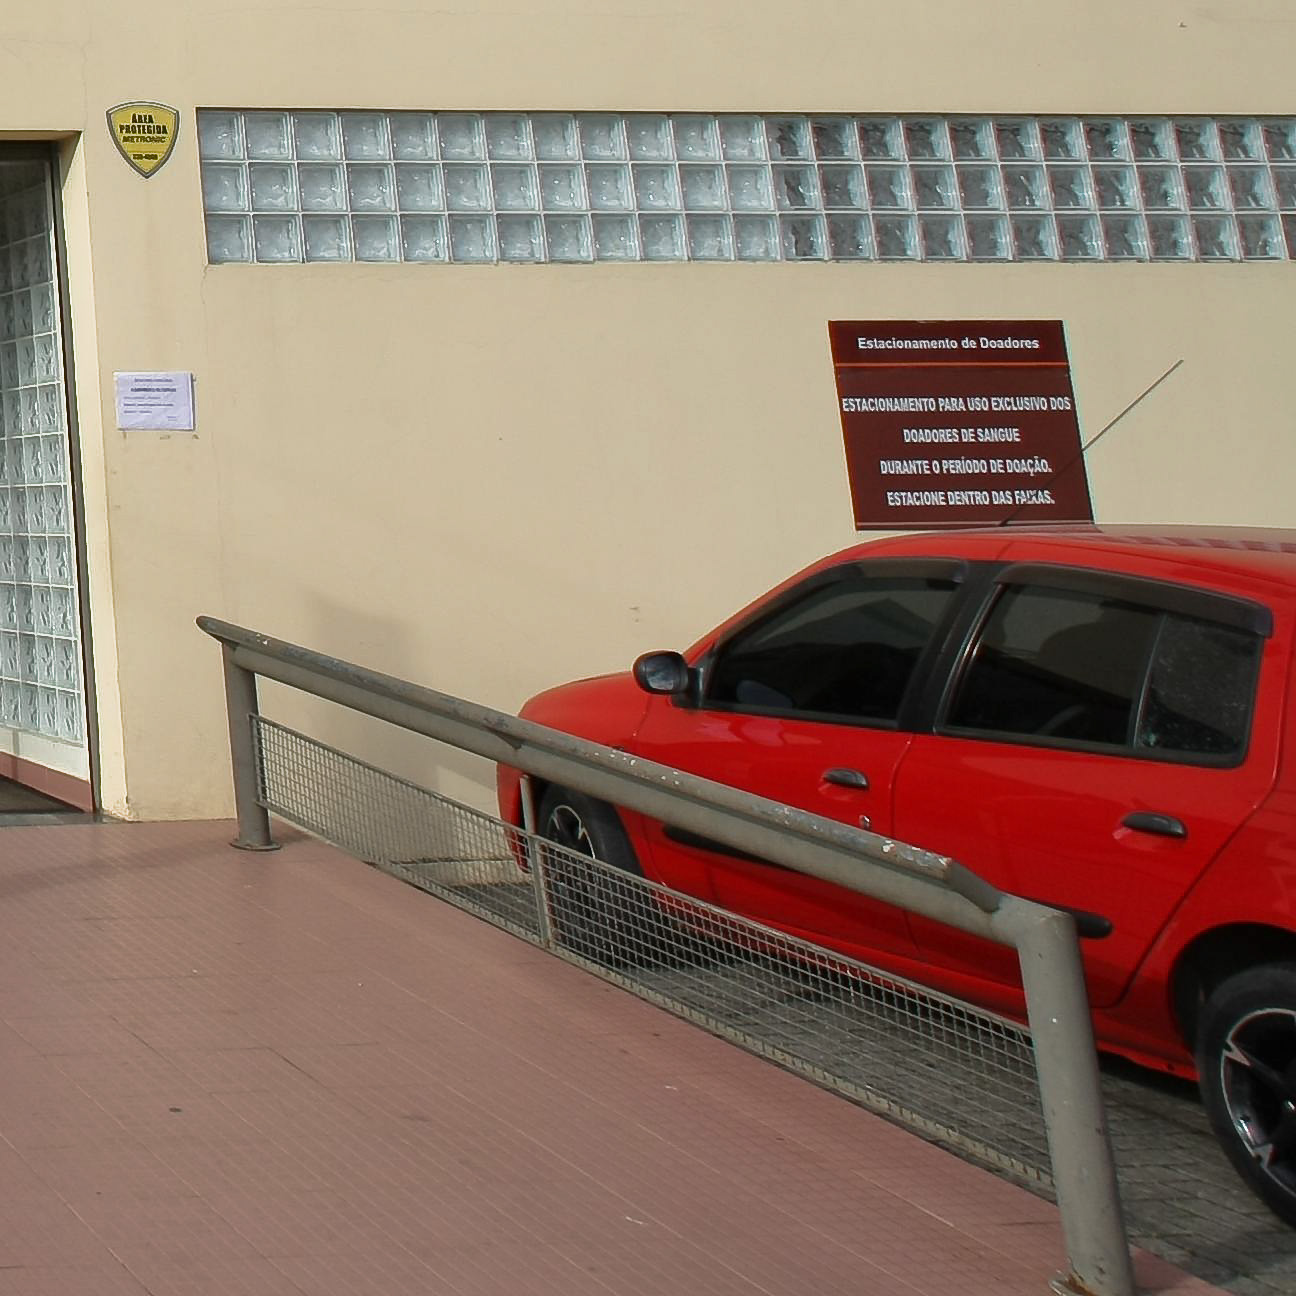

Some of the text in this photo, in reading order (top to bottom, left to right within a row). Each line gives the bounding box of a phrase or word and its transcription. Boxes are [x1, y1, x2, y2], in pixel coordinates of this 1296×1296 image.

[119, 124, 168, 135] PROTEGIDA
[857, 337, 1040, 349] Estacionamento de Doadores
[842, 396, 1072, 412] ESTACIONAMENTO PARA USO EXCLUSIVO DOS
[903, 428, 1021, 443] DOADORES DE SANGUE
[880, 456, 1053, 476] DURANTE O PERÍODO DE DOAÇÃO.
[887, 490, 946, 506] ESTACIONE
[948, 490, 989, 505] DENTRO
[992, 490, 1012, 505] DAS
